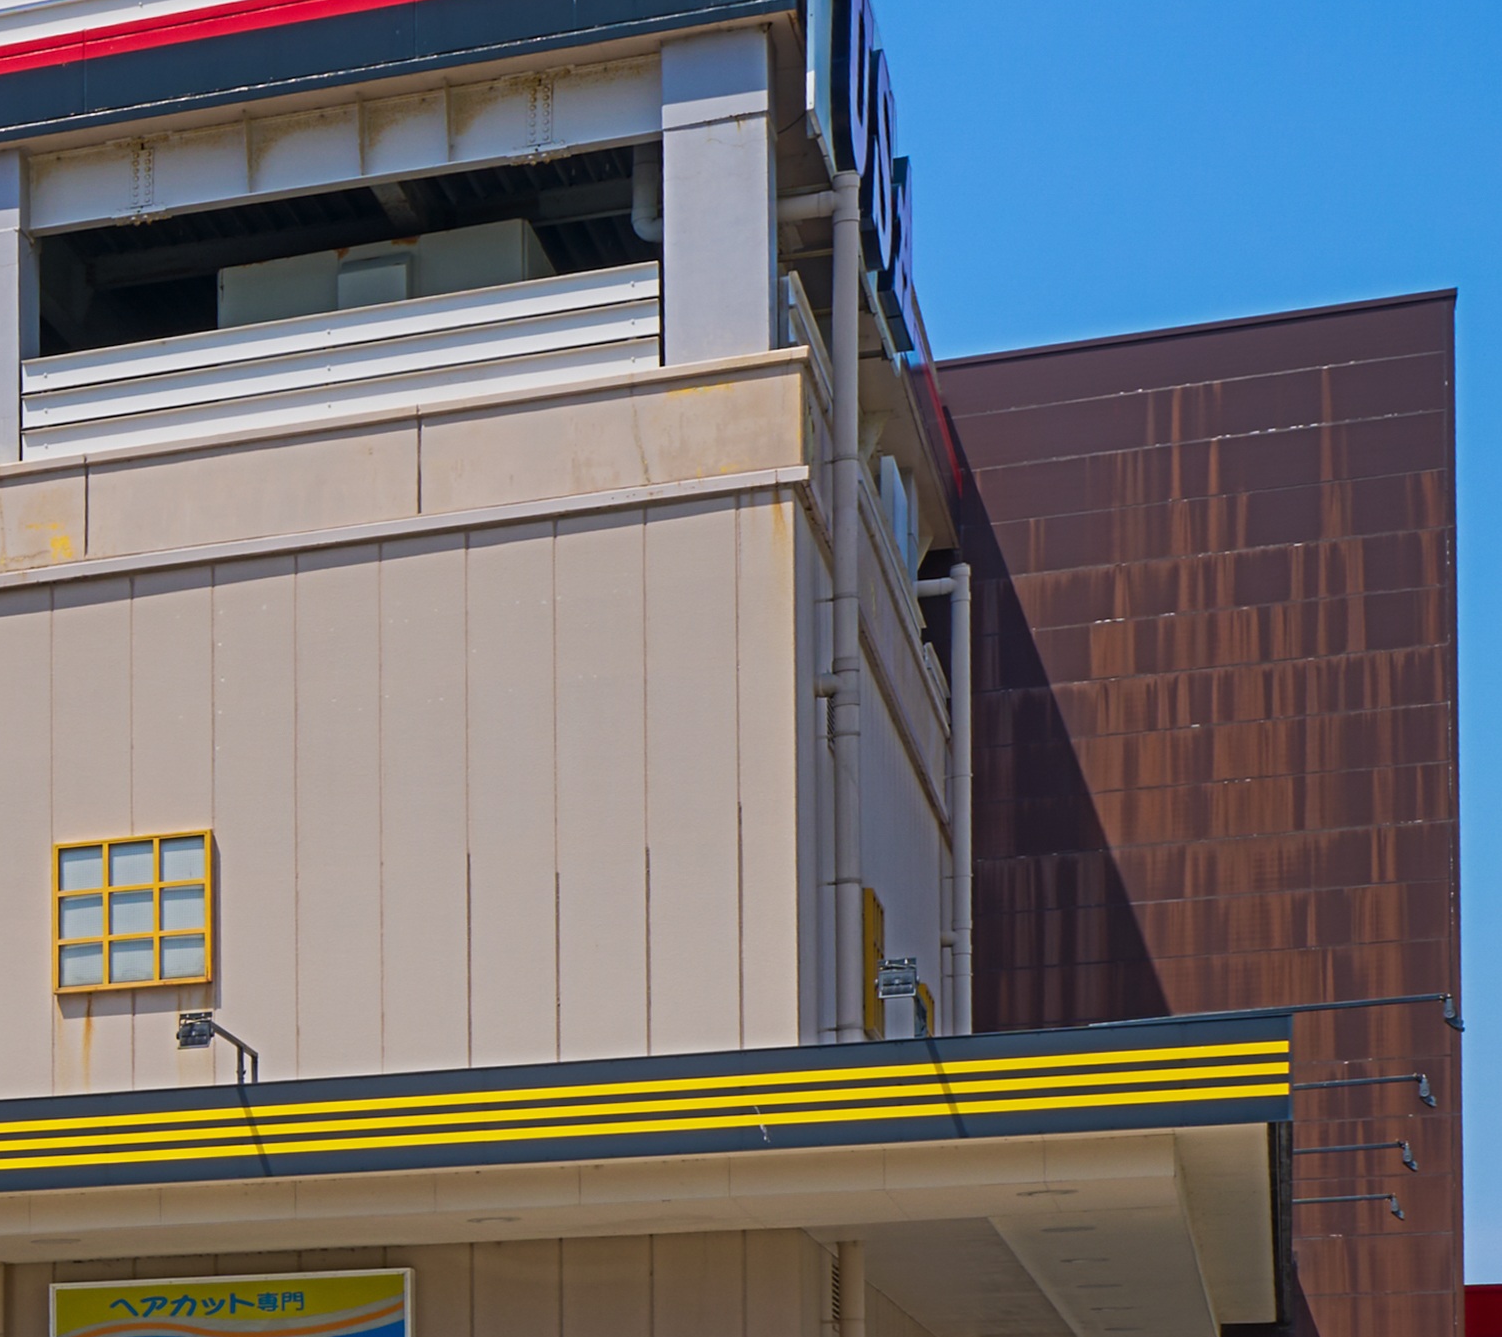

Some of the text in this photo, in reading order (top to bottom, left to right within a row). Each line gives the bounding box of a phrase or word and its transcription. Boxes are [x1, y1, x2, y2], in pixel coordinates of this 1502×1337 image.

[109, 1291, 306, 1318] ヘアカット専門
